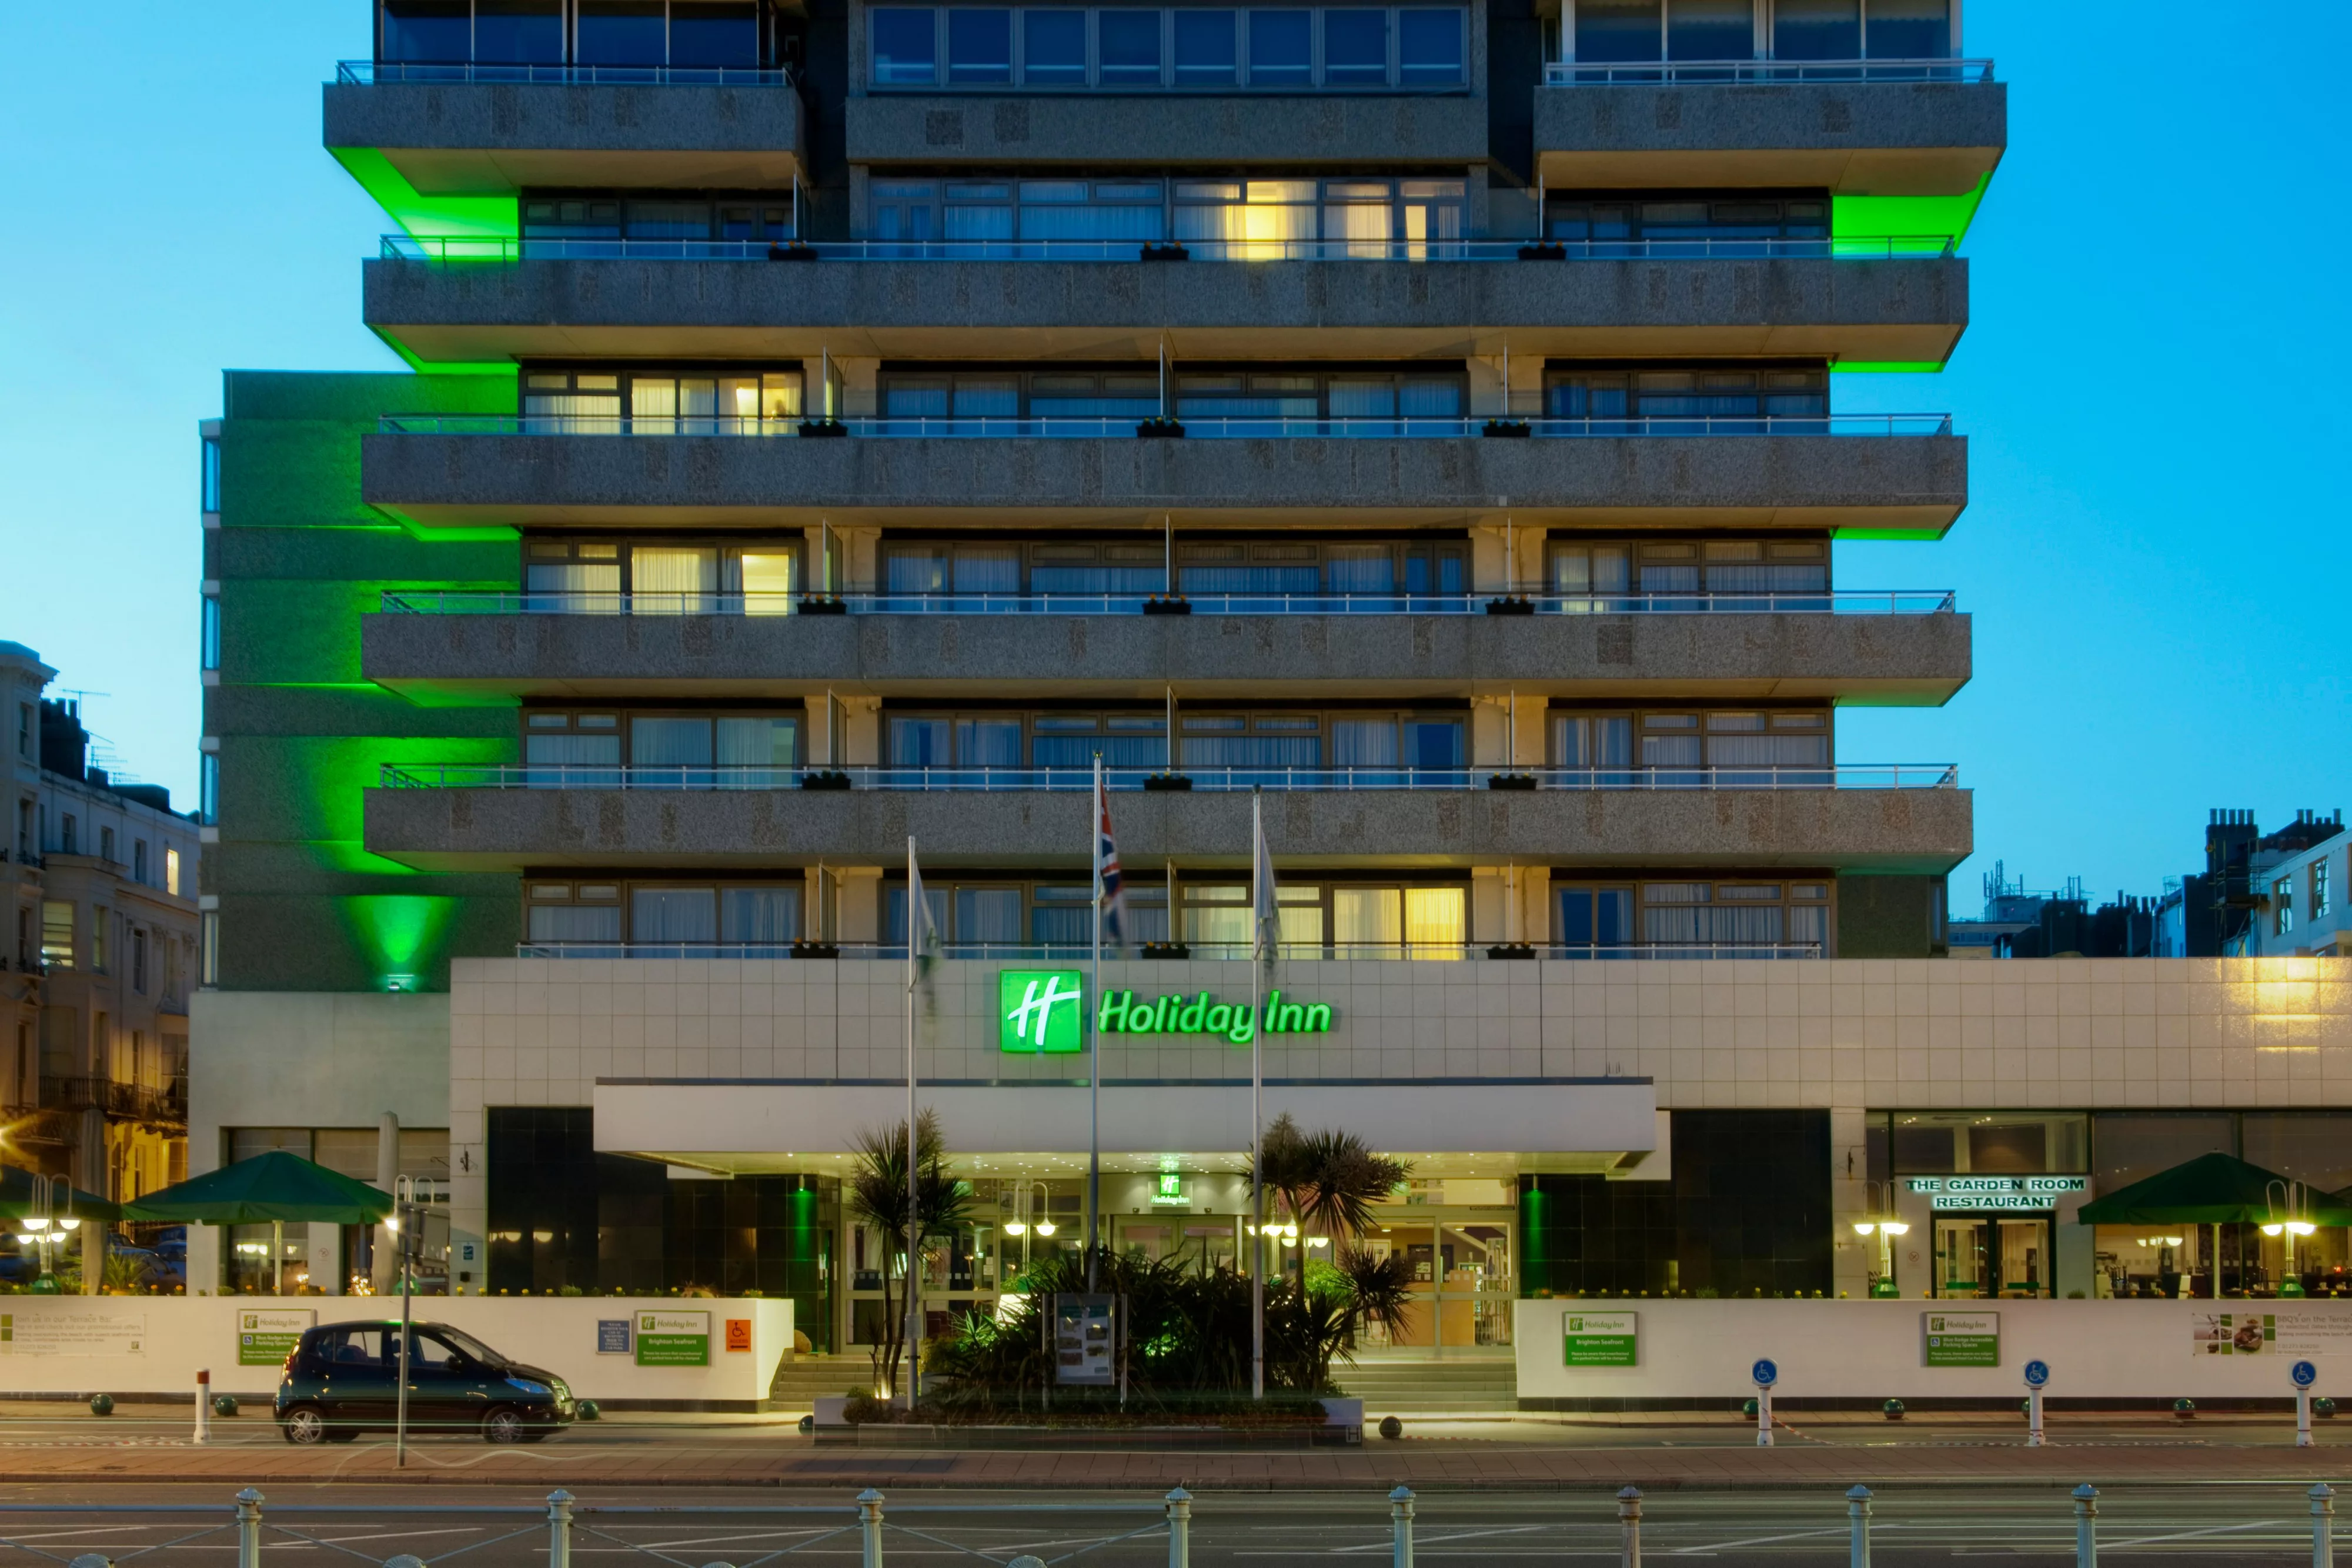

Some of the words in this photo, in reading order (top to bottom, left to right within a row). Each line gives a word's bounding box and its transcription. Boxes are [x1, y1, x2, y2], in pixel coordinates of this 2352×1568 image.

[1098, 989, 1254, 1044] Holiday
[1264, 989, 1332, 1032] Inn
[1906, 1179, 1940, 1190] THE
[1949, 1179, 2023, 1190] GARDEN
[2031, 1179, 2084, 1189] ROOM
[1151, 1195, 1178, 1205] Holiday
[1178, 1195, 1190, 1203] Inn
[1936, 1196, 2054, 1207] RESTAURANT
[260, 1318, 287, 1328] Holiday
[657, 1319, 684, 1329] Holiday
[1585, 1320, 1612, 1329] Holiday
[1946, 1320, 1974, 1330] Holiday
